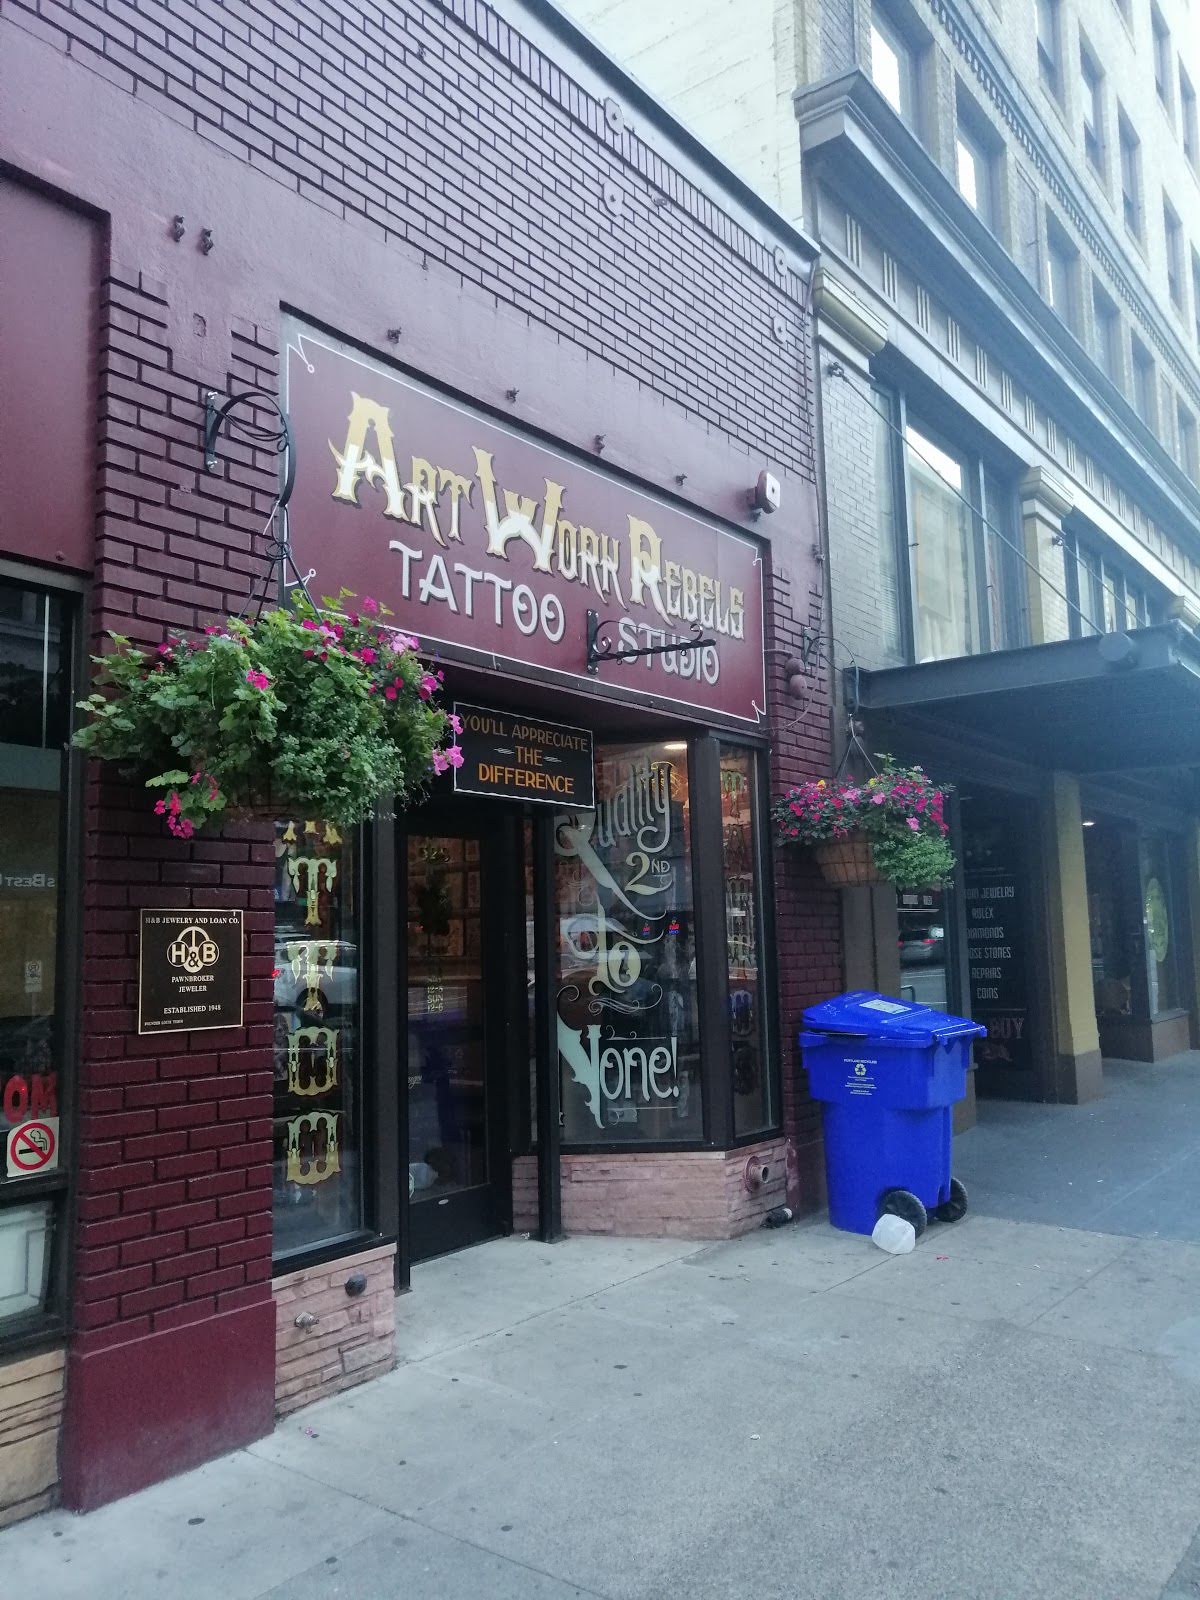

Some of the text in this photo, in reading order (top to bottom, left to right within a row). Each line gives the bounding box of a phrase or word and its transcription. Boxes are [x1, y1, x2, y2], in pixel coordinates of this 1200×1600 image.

[626, 514, 745, 640] REBELS
[388, 540, 565, 643] TATTOO
[617, 616, 720, 686] STUDIO
[460, 712, 589, 753] YOU'LL APPRECIATE
[514, 745, 543, 767] THE
[478, 763, 575, 795] DIFFERENCE
[982, 886, 1015, 899] JEWELRY
[971, 907, 994, 919] ROLEX
[161, 917, 193, 925] JEWELRY
[194, 917, 208, 925] AND
[209, 917, 228, 925] LOAN
[228, 917, 240, 925] CO.
[984, 946, 1012, 959] STONES
[171, 975, 215, 984] PAWNBROKER
[971, 967, 1002, 979] REPAIRS
[178, 985, 207, 994] JEWELER
[976, 987, 999, 999] COINS
[427, 994, 444, 1004] SUN
[163, 1005, 207, 1015] ESTABLISHED
[556, 1009, 680, 1129] None!
